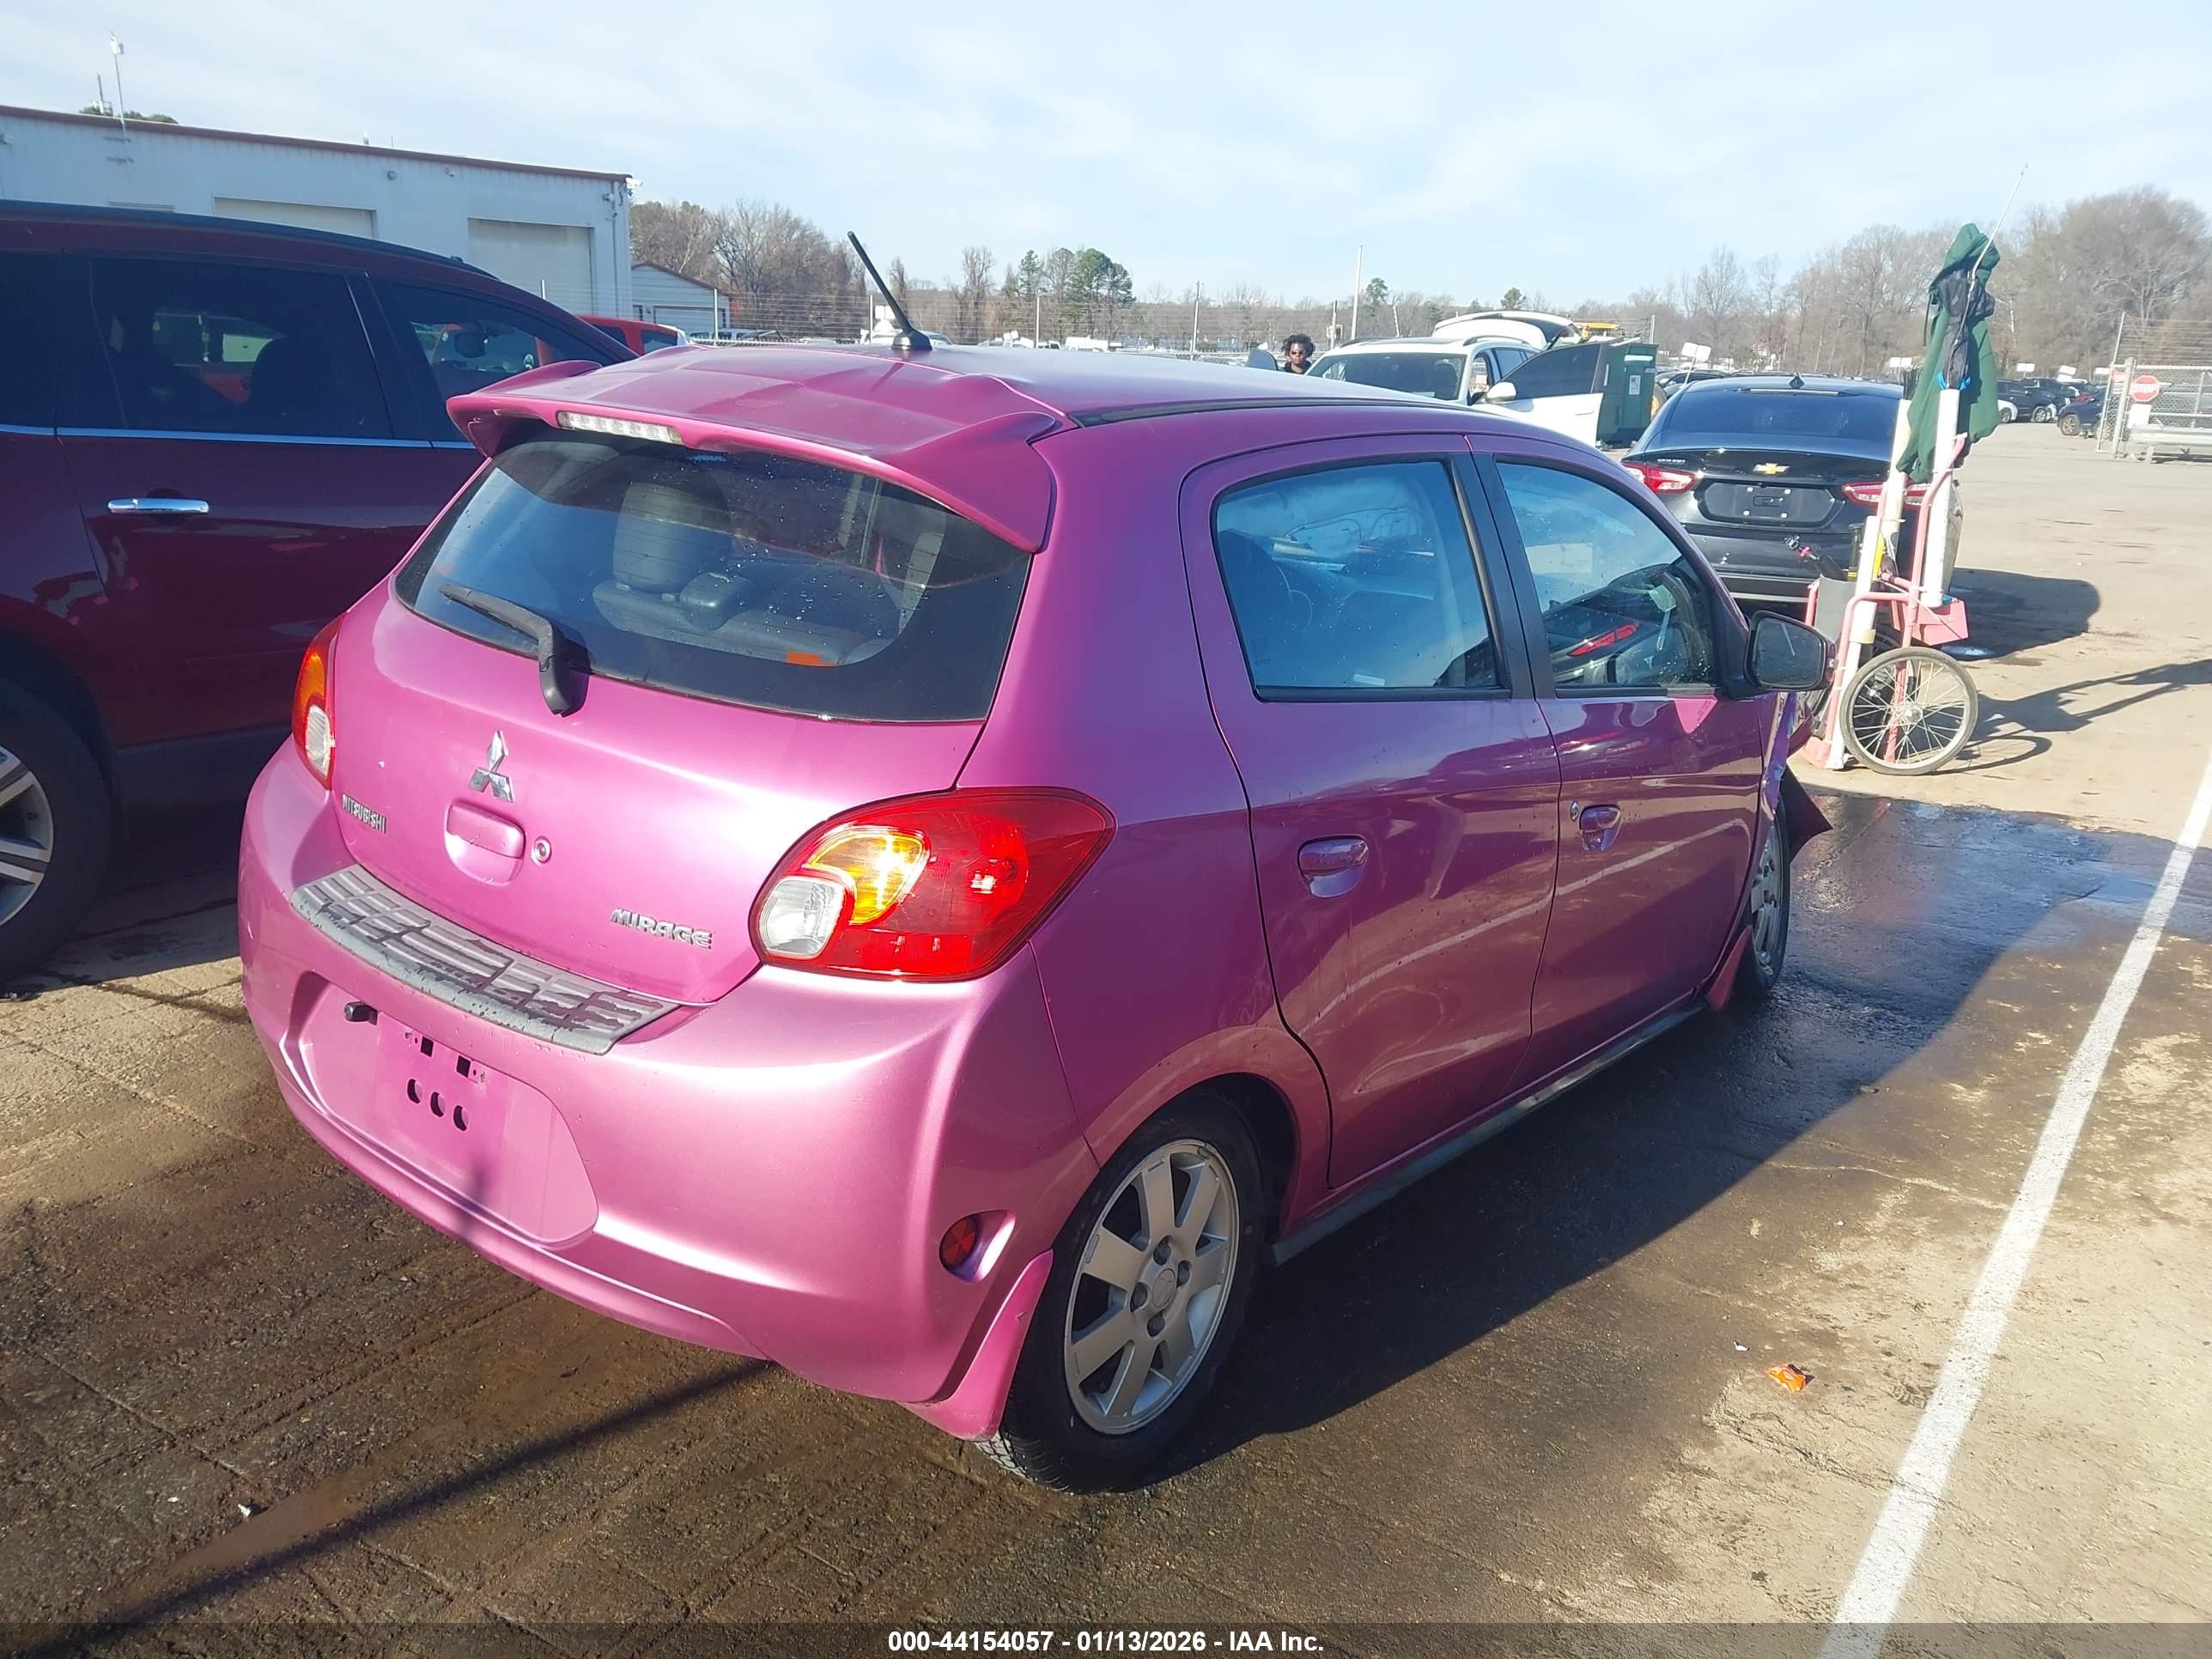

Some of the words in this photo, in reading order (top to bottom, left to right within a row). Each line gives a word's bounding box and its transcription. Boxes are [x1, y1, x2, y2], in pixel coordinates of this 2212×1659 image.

[2133, 383, 2157, 393] STOP
[342, 793, 386, 834] MITSUBISHI
[611, 908, 712, 950] MIRAGE
